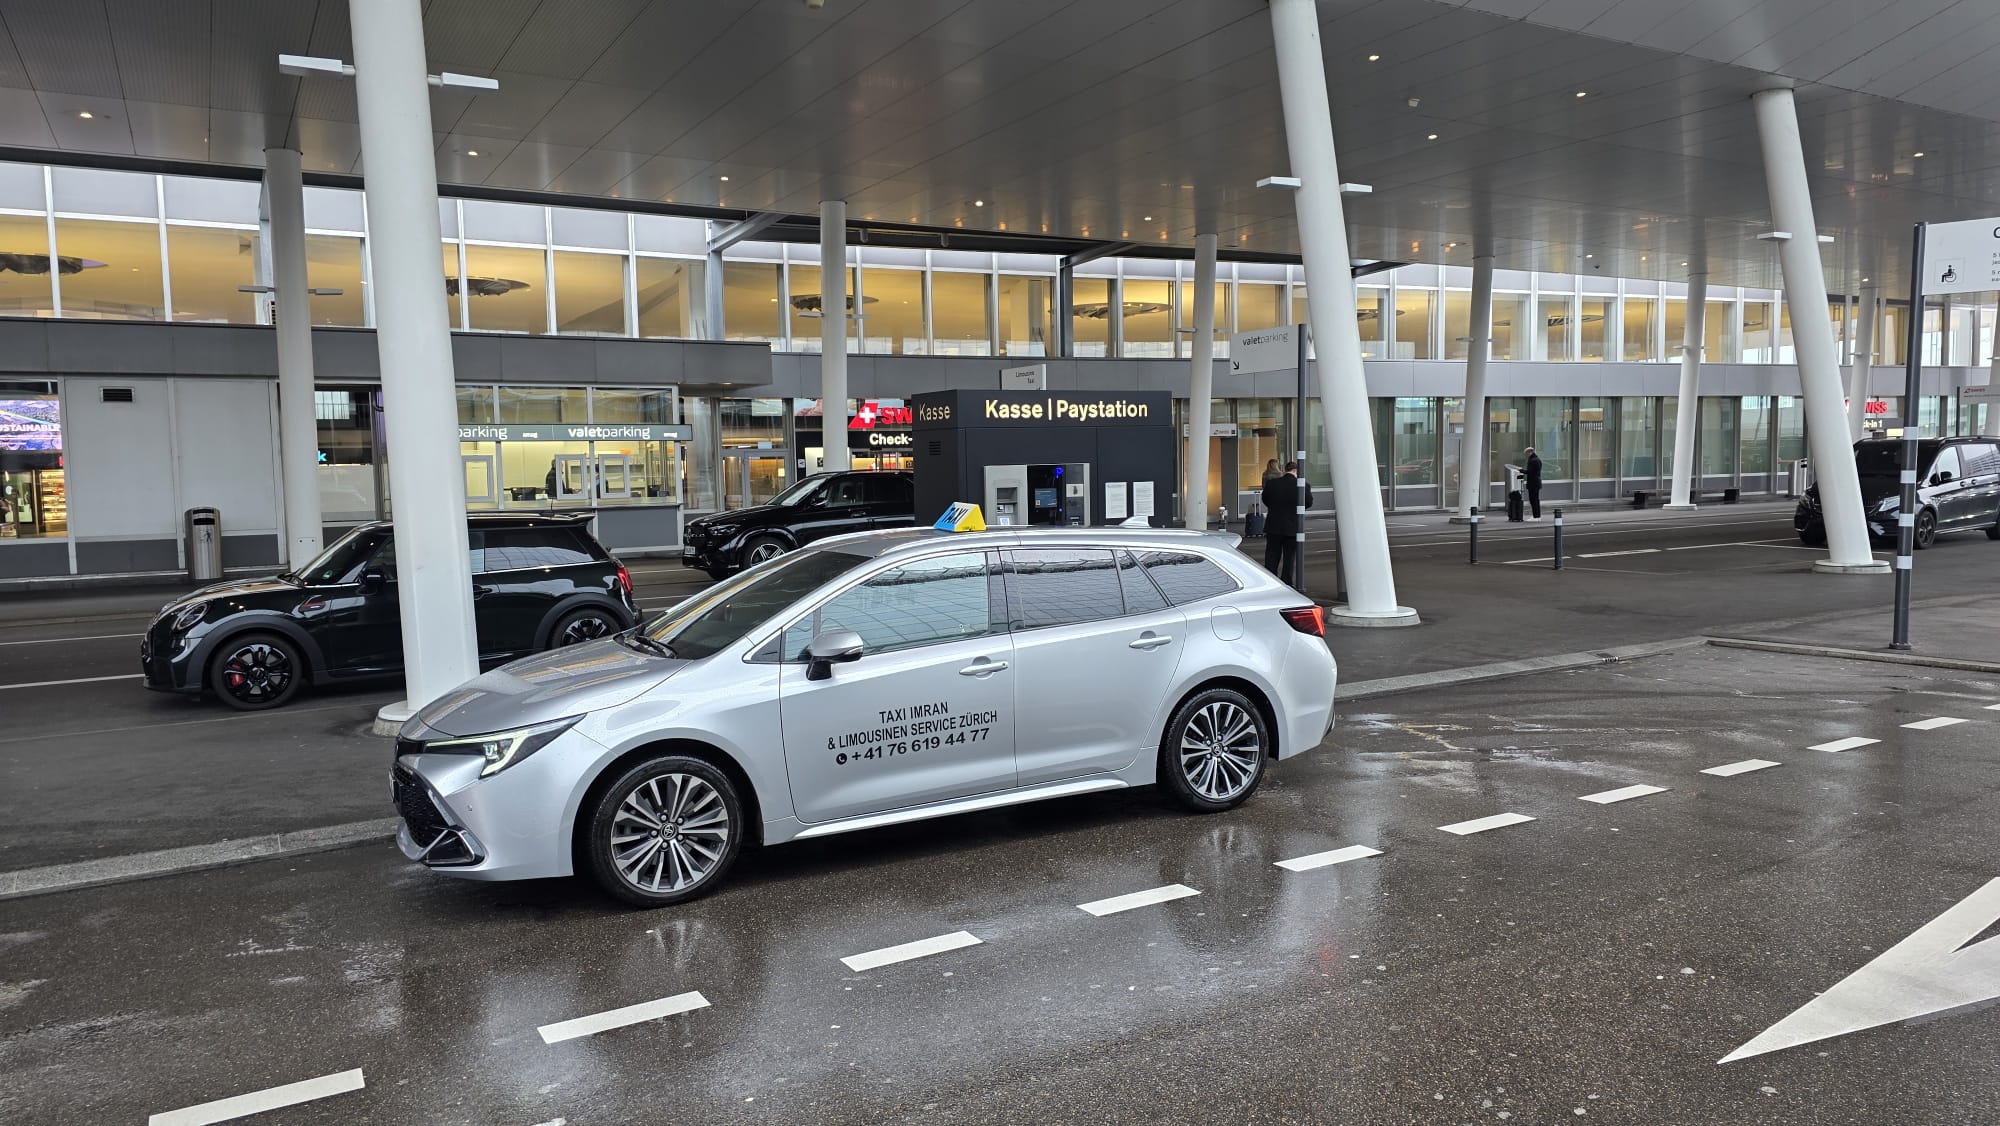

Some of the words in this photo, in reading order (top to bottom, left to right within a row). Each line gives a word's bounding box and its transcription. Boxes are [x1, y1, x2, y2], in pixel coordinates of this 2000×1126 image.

[1243, 332, 1288, 345] valetparking
[919, 402, 950, 421] Kasse
[985, 399, 1043, 419] Kasse
[1056, 399, 1148, 421] Paystation
[567, 426, 650, 440] valetparking
[879, 708, 906, 724] TAXI
[910, 702, 948, 719] IMRAN
[828, 737, 836, 750] &
[839, 725, 908, 749] LIMOUSINEN
[911, 717, 957, 736] SERVICE
[959, 710, 998, 728] ZÜRICH
[887, 742, 907, 756] 76
[911, 736, 940, 752] 619
[945, 732, 966, 745] 44
[970, 728, 990, 742] 77
